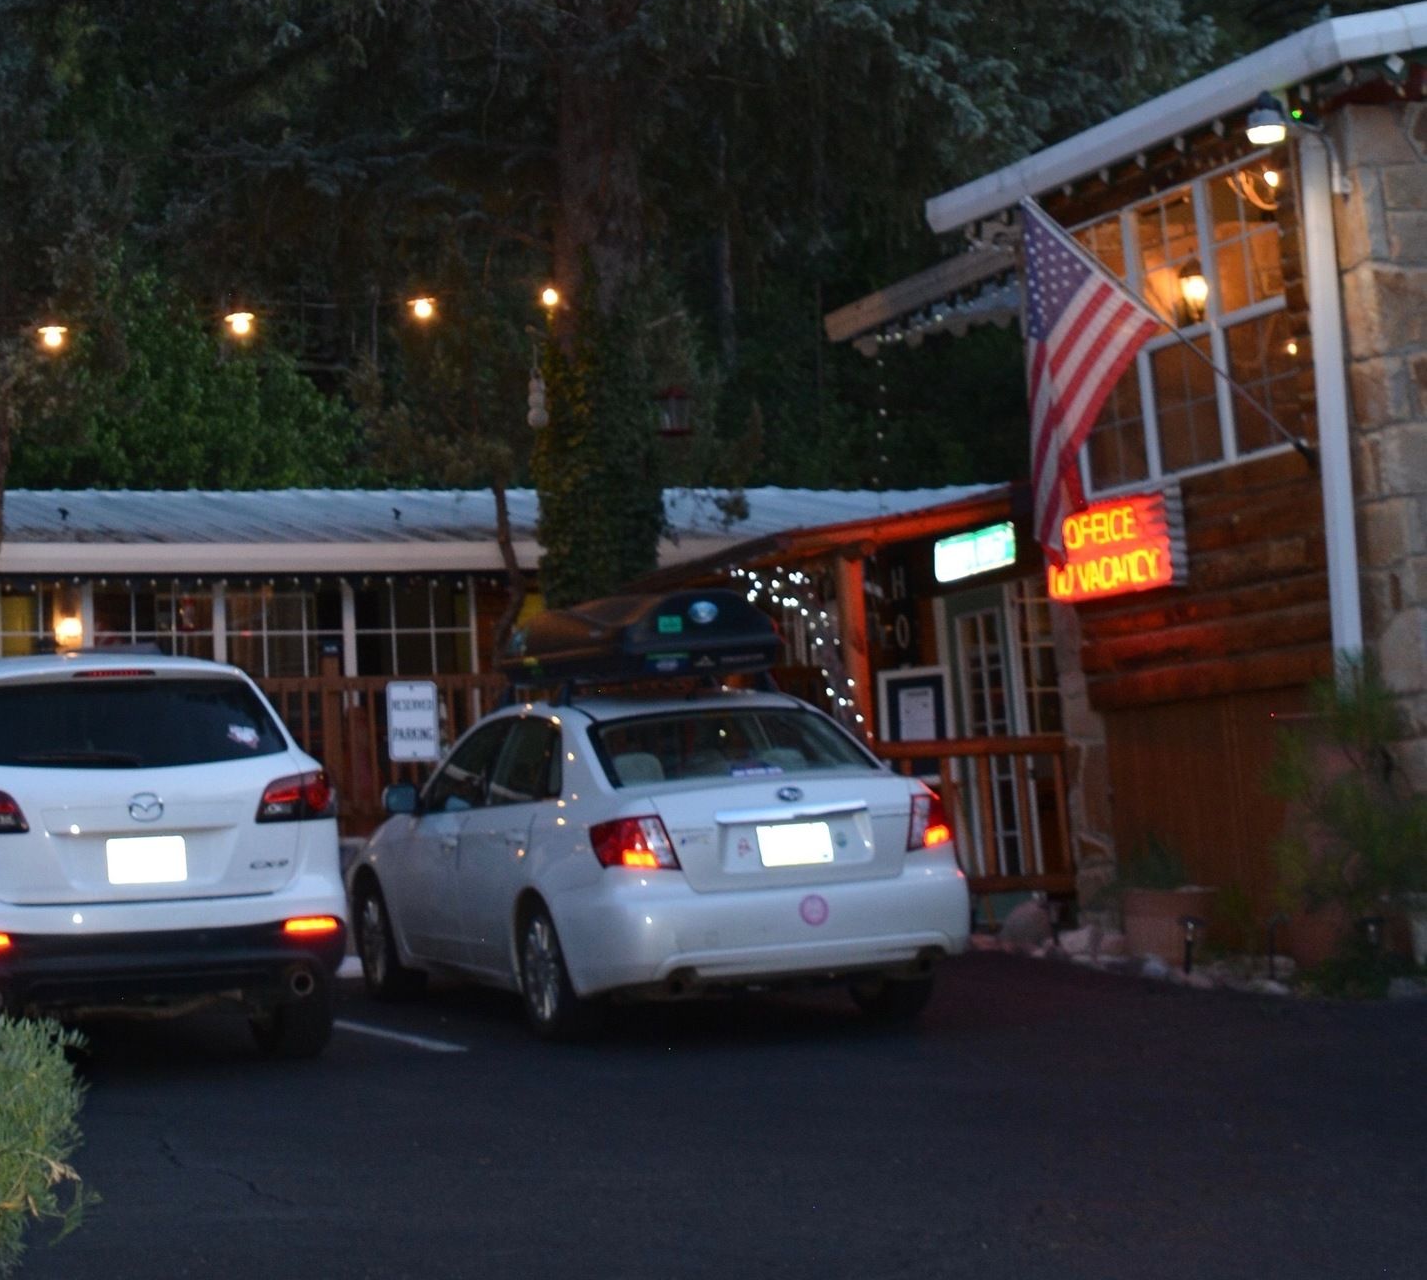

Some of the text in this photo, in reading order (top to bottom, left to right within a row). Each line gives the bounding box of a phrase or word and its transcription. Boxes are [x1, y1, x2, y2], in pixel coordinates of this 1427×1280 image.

[1063, 505, 1136, 549] OFFICE
[1076, 547, 1161, 592] VACANCY
[391, 699, 435, 711] RESERVED
[392, 727, 435, 742] PARKING
